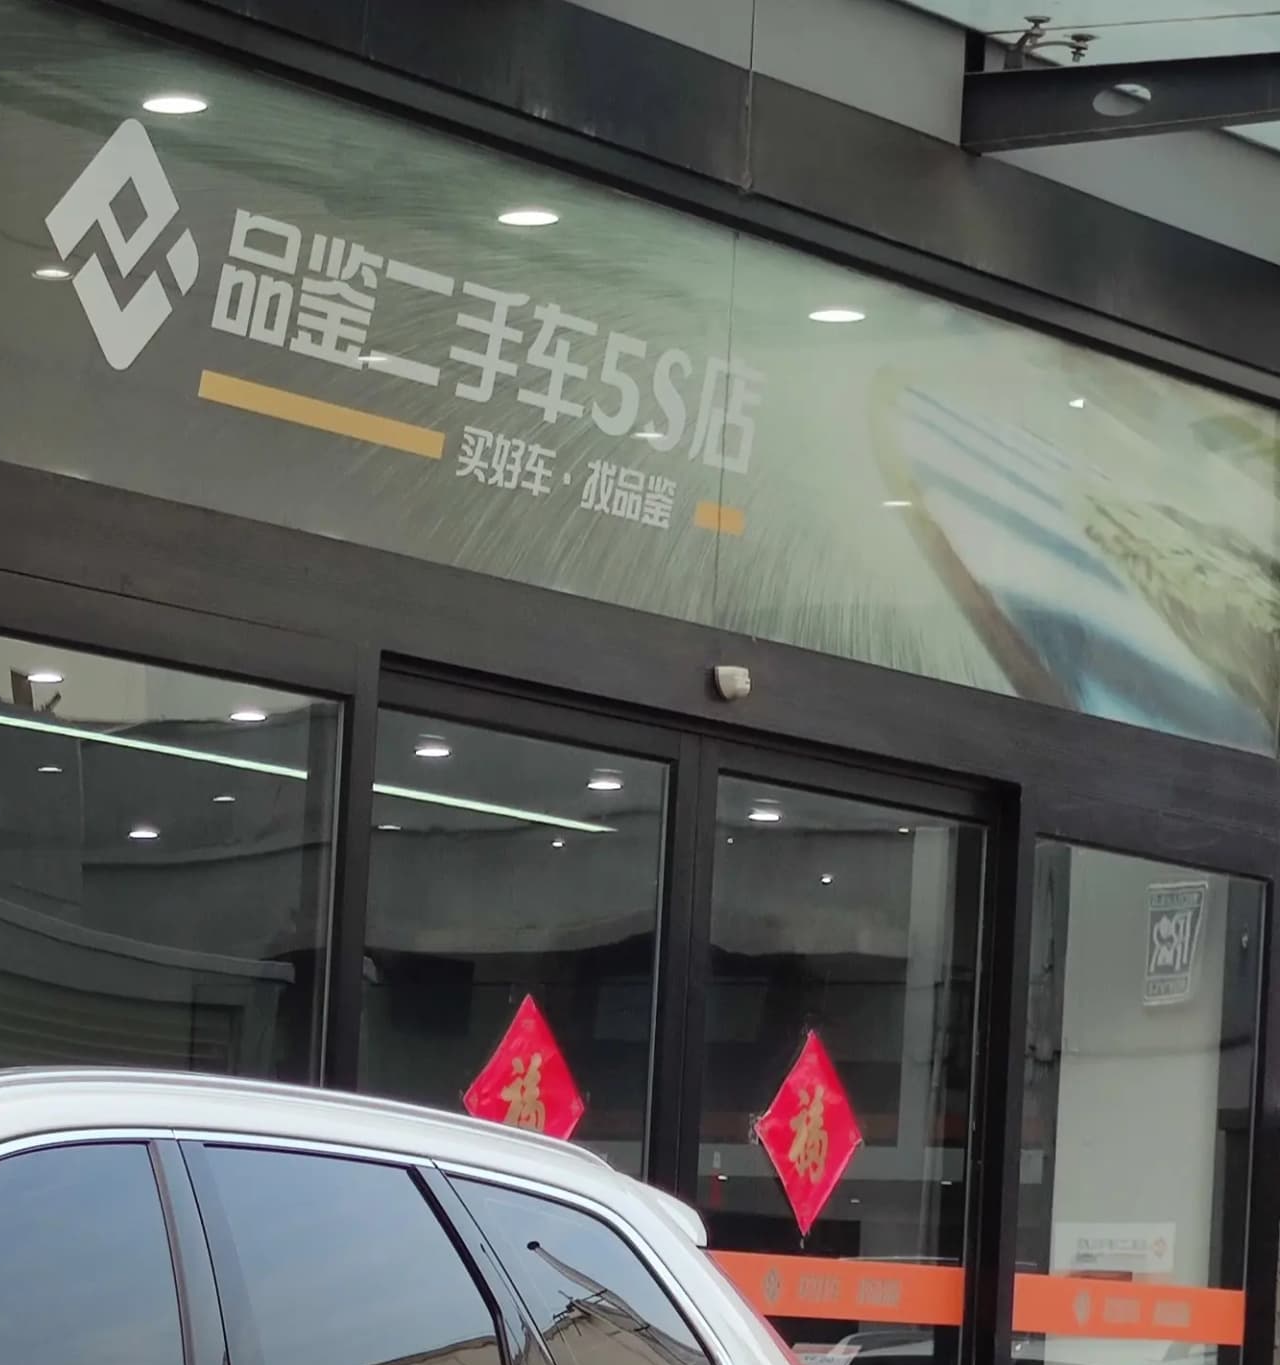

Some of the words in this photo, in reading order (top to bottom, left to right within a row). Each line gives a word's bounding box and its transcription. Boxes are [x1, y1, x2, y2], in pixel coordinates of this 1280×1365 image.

[211, 208, 767, 475] 品鉴二手车5S店
[787, 1084, 830, 1184] 福
